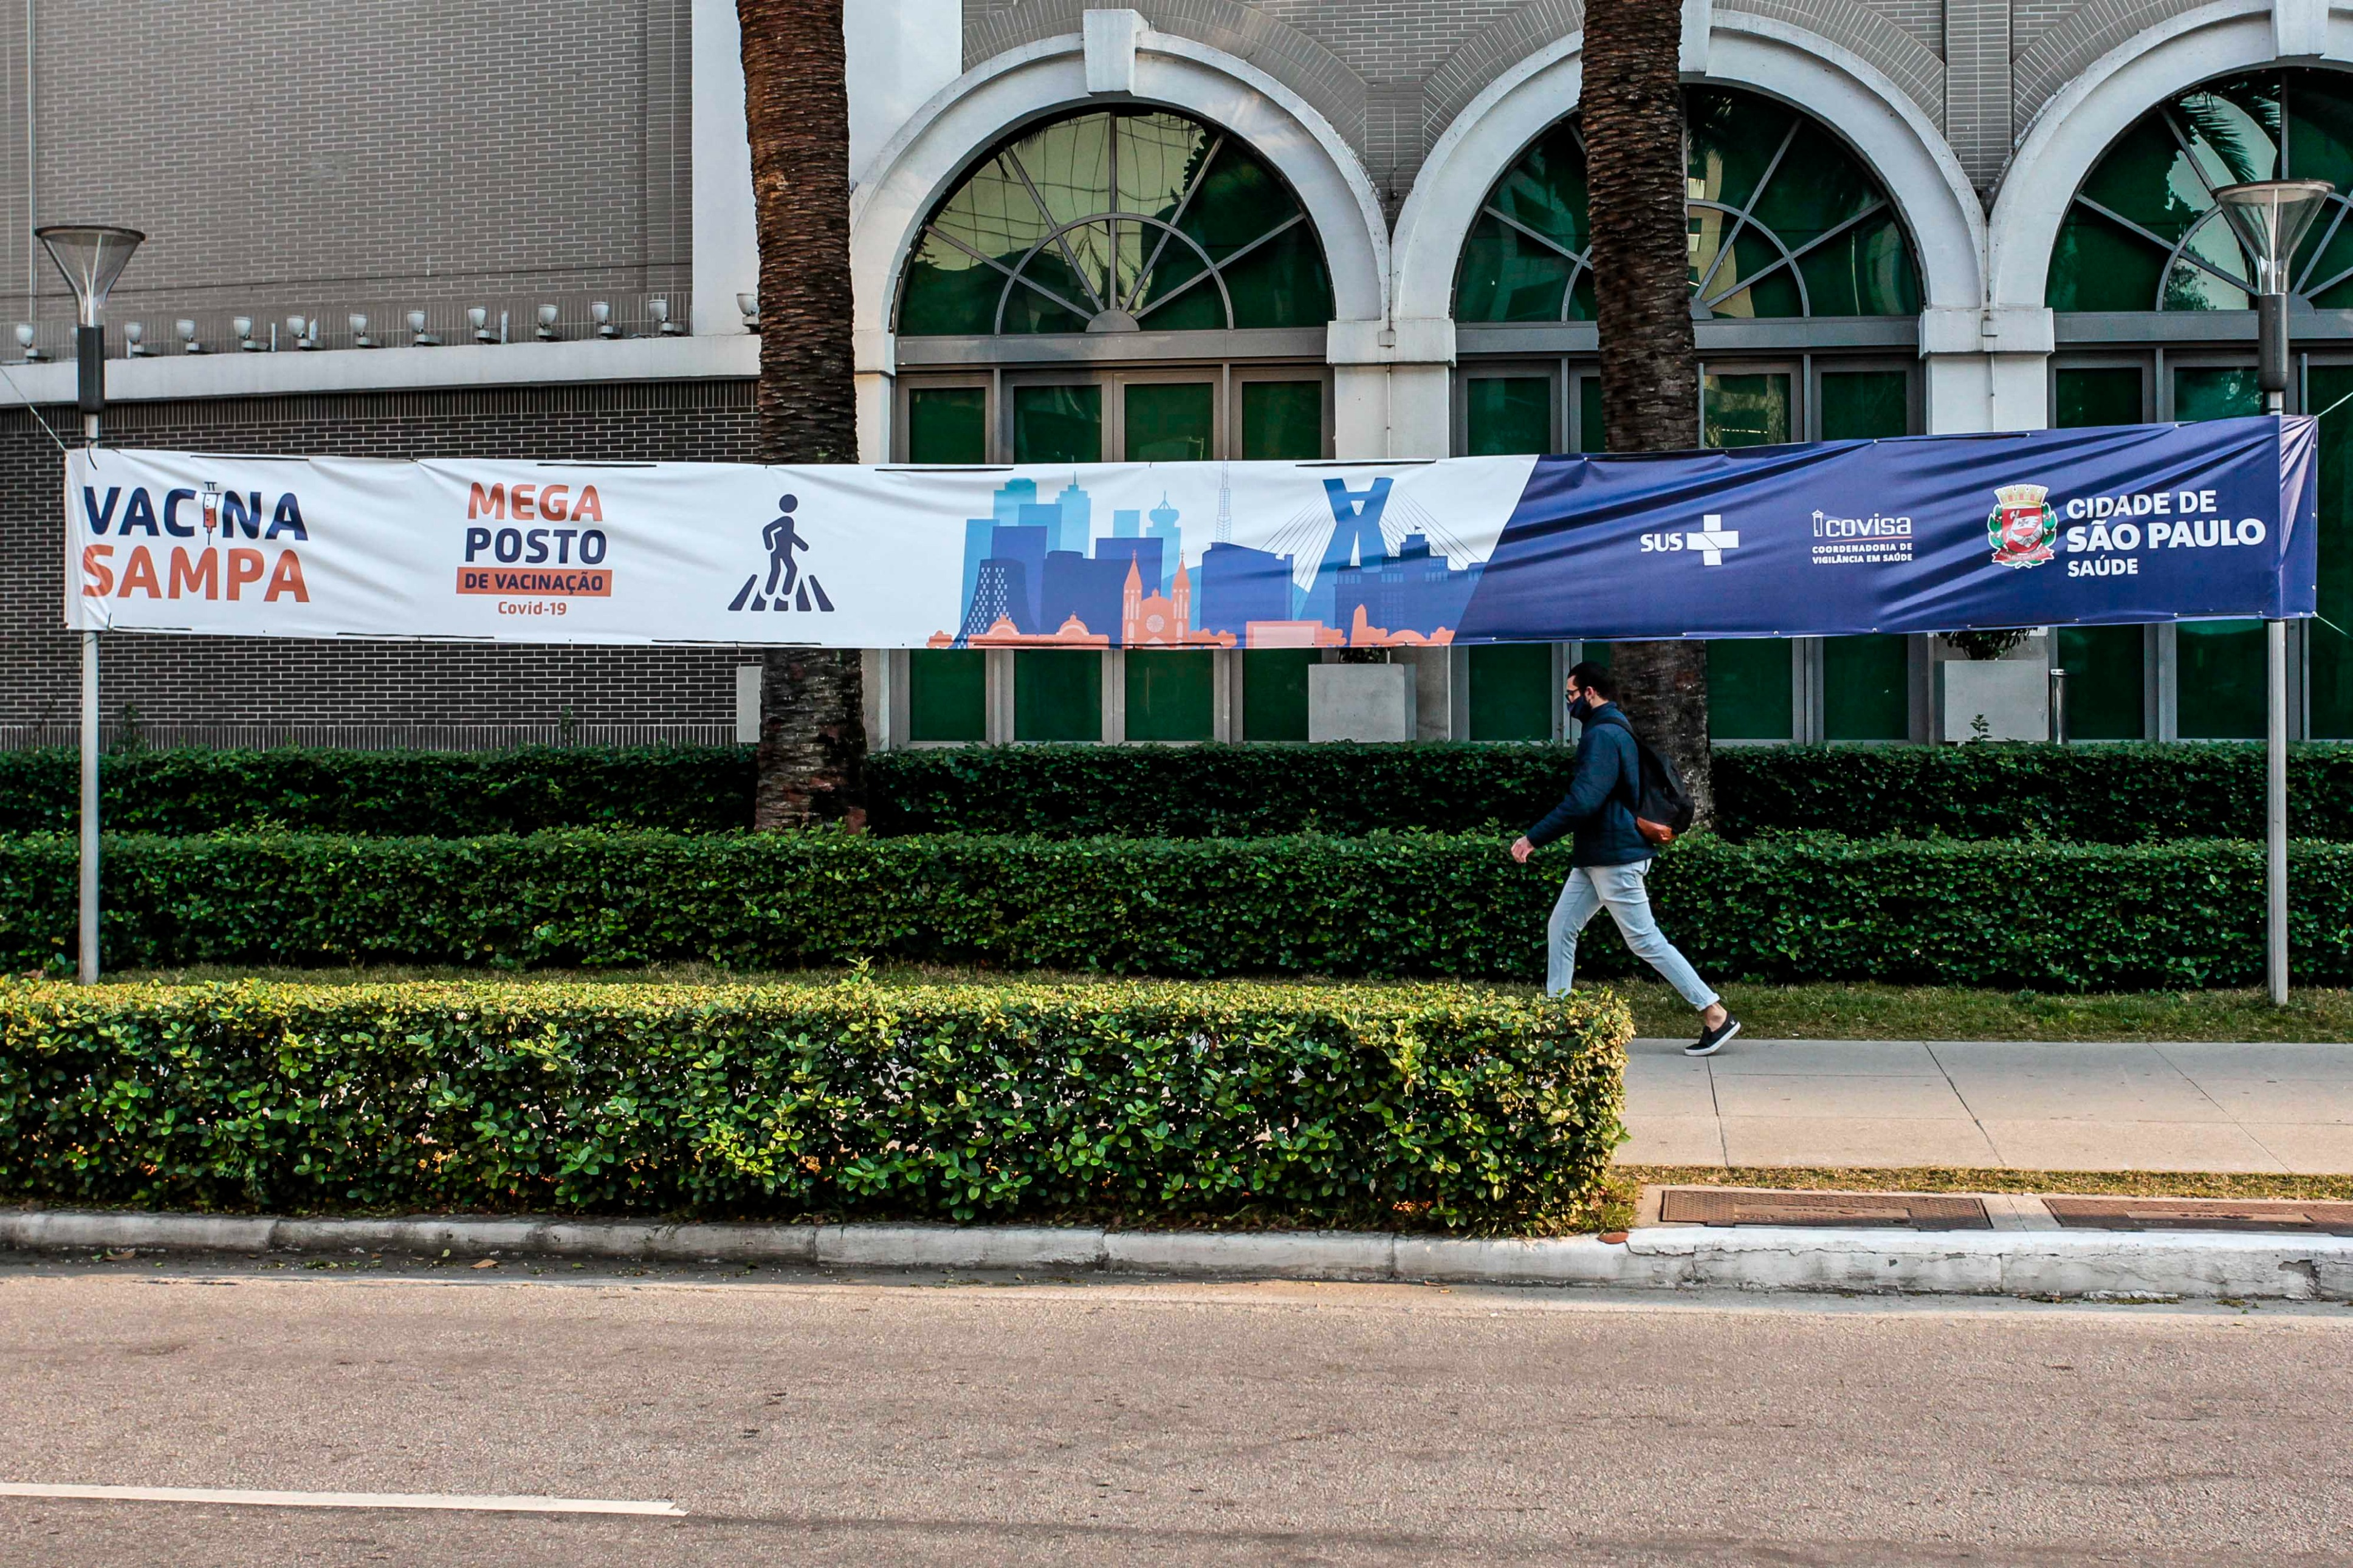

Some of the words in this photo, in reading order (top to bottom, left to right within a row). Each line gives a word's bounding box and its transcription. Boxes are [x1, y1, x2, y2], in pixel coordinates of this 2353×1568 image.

[84, 482, 309, 541] VACINA
[468, 482, 603, 521] MEGA
[2067, 493, 2171, 519] CIDADE
[2179, 490, 2217, 514] DE
[465, 528, 606, 564] POSTO
[1640, 532, 1684, 552] SUS
[2067, 520, 2141, 552] SÃO
[2148, 518, 2267, 549] PAULO
[1812, 544, 1897, 554] COORDENADORIA
[1900, 543, 1913, 551] DE
[1812, 554, 1864, 564] VIGILÂNCIA
[1866, 554, 1881, 563] EM
[1883, 552, 1913, 562] SAÚDE
[83, 545, 310, 602] SAMPA
[2067, 555, 2138, 577] SAÚDE
[464, 573, 489, 590] DE
[494, 572, 603, 595] VACINAÇÃO
[498, 601, 567, 616] Covid-19
